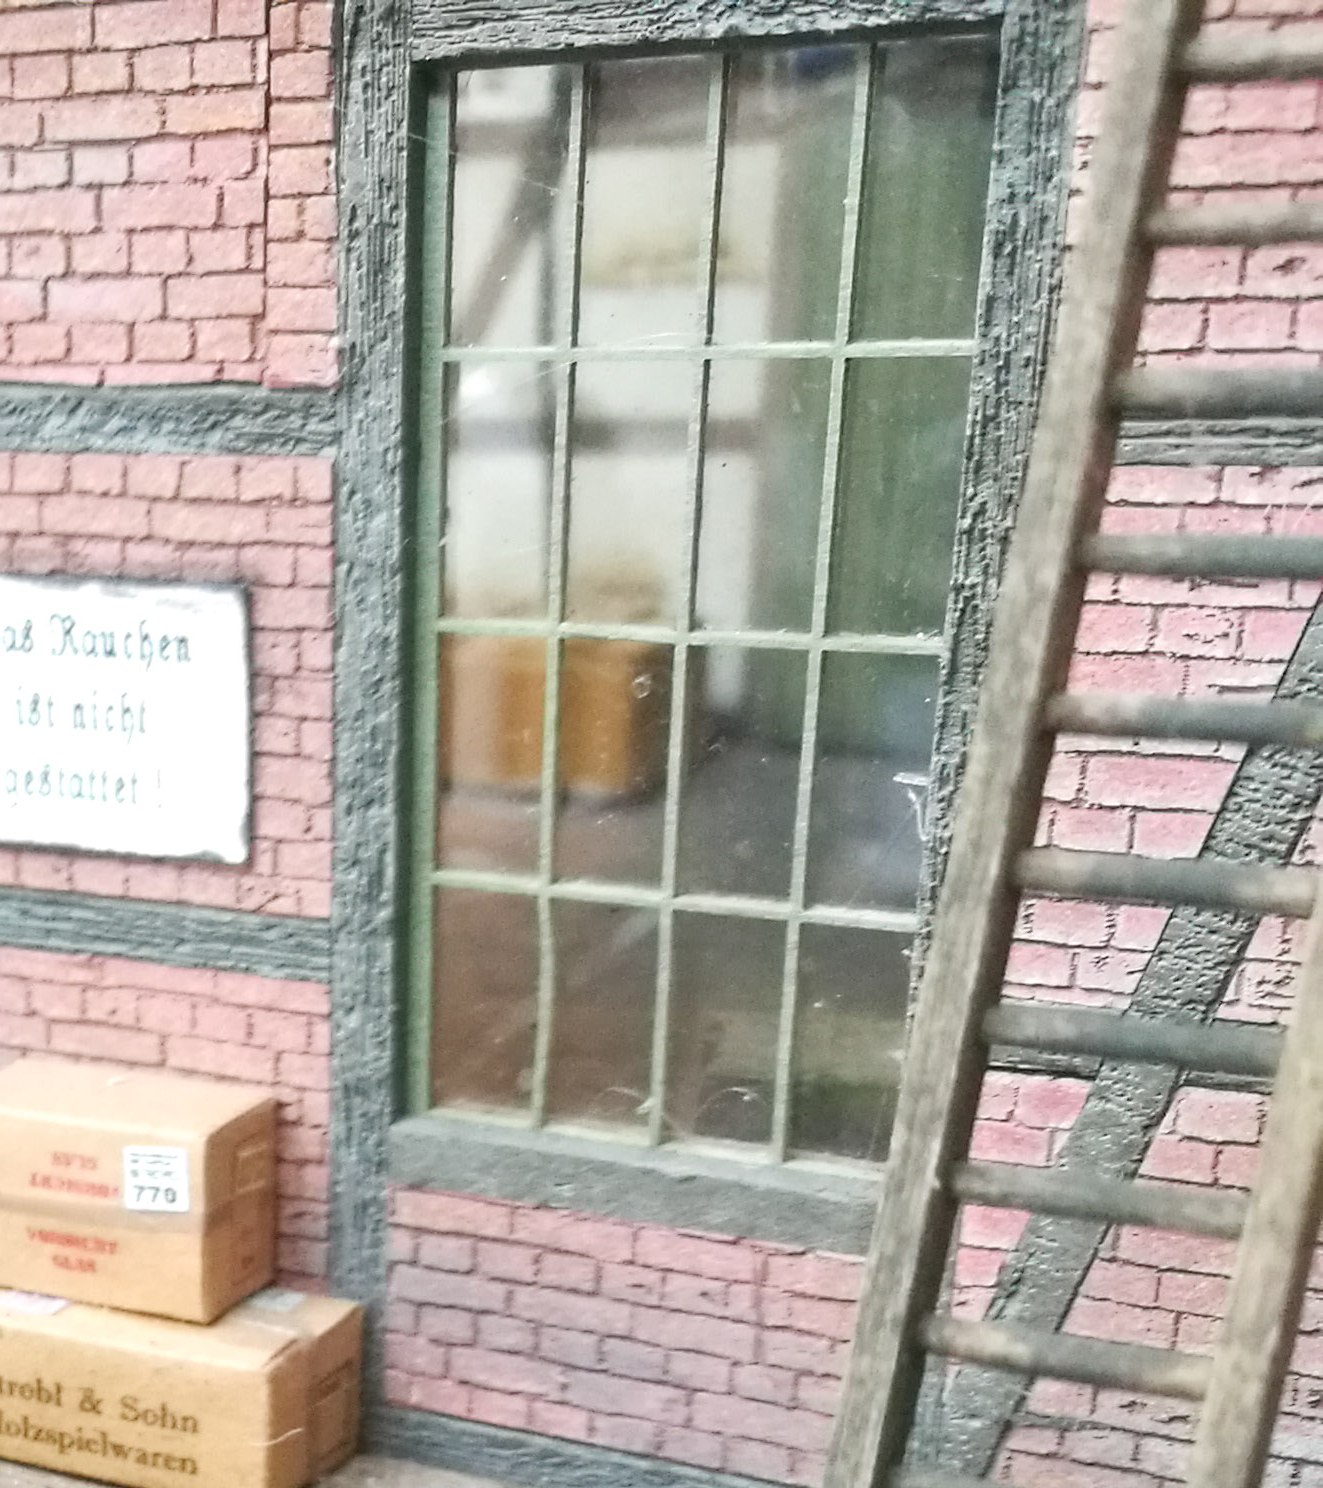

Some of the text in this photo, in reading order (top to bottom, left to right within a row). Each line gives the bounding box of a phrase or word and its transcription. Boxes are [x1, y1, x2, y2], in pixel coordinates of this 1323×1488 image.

[50, 613, 192, 672] Rauchen
[16, 686, 147, 745] ist nicht
[78, 1386, 103, 1416] &
[120, 1395, 200, 1434] Sohn
